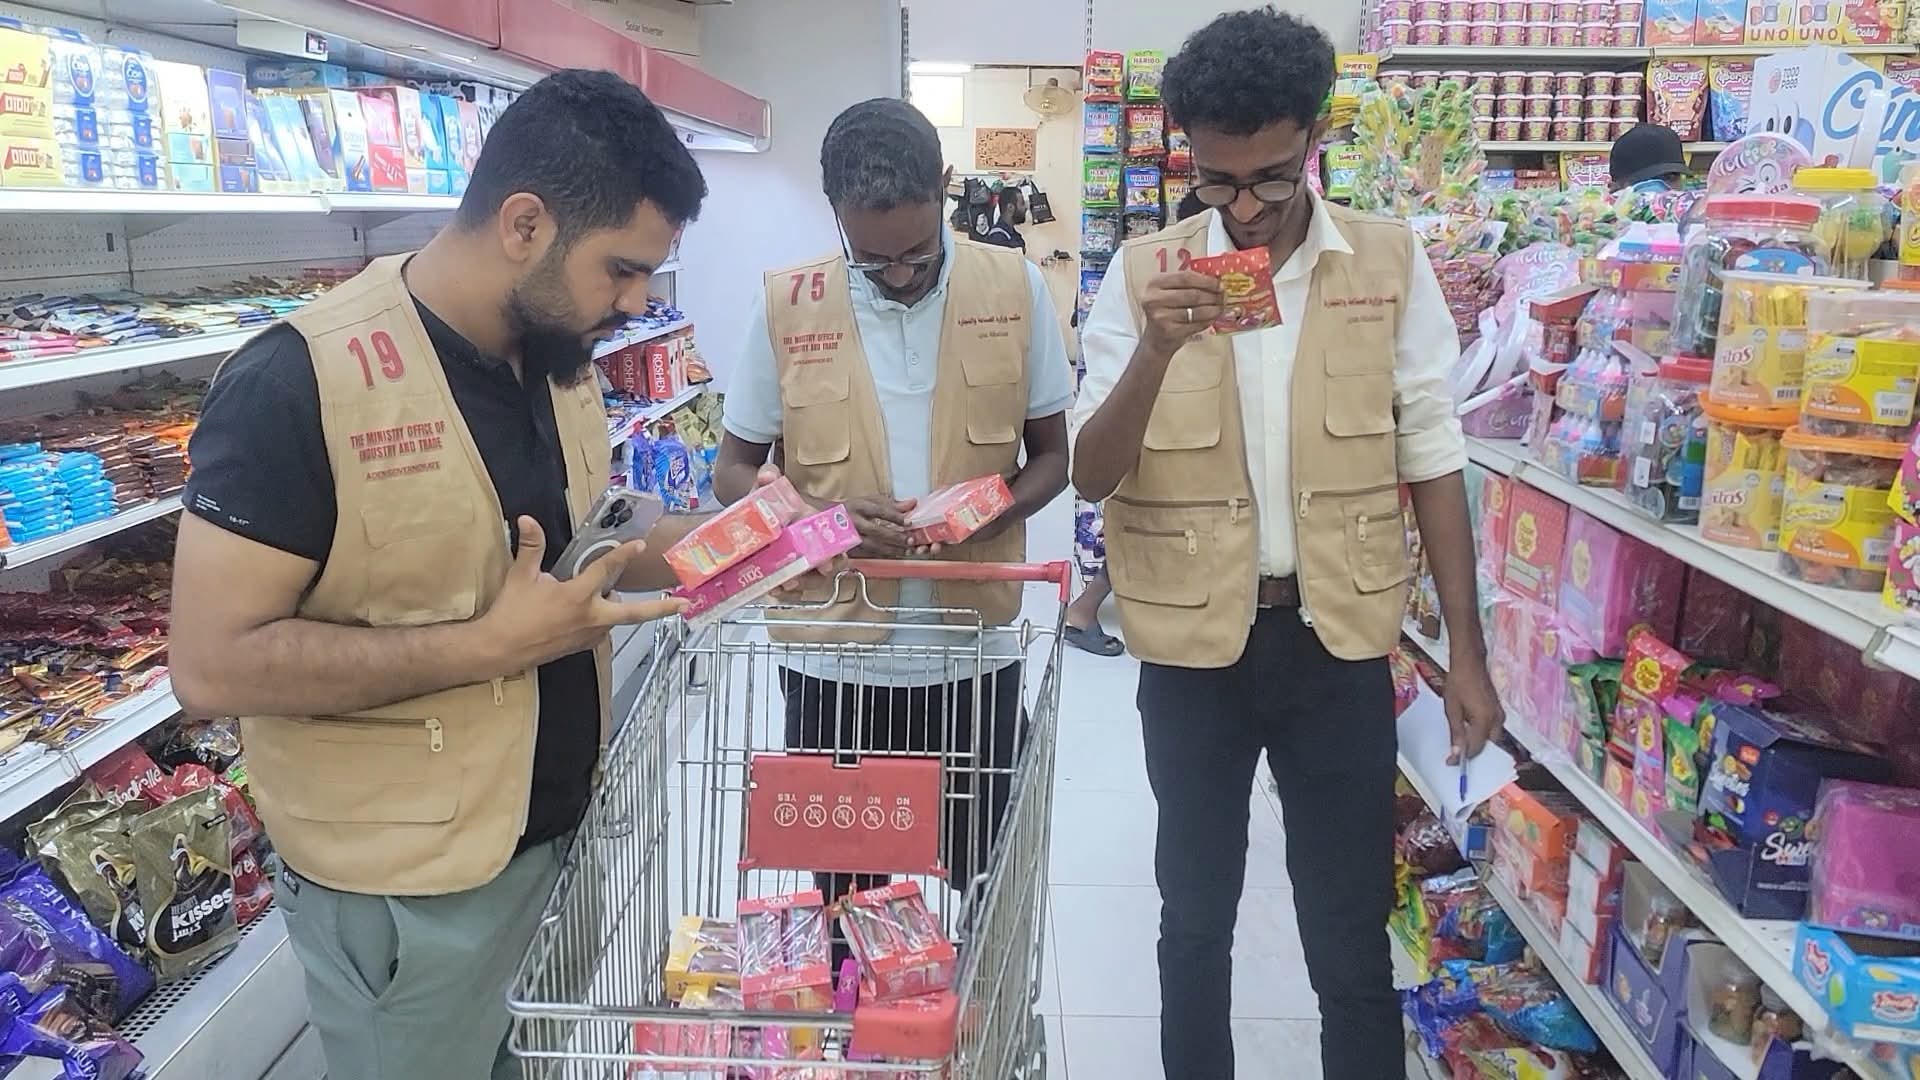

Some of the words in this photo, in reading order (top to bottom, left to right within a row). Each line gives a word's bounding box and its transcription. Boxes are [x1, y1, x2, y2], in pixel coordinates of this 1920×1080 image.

[1751, 28, 1789, 41] UNO
[1800, 28, 1838, 41] UNO
[790, 271, 826, 306] 75
[347, 330, 405, 388] 19
[653, 353, 666, 394] ROSHEN
[350, 435, 365, 449] THE
[366, 428, 404, 446] MINISTRY
[407, 423, 434, 436] OFFICE
[435, 420, 446, 432] OF
[359, 444, 397, 462] INDUSTRY
[399, 441, 416, 454] AND
[419, 437, 443, 450] TRADE
[777, 793, 797, 802] YES
[809, 794, 823, 803] NO
[838, 795, 852, 803] NO
[867, 796, 881, 805] NO
[896, 797, 910, 806] NO
